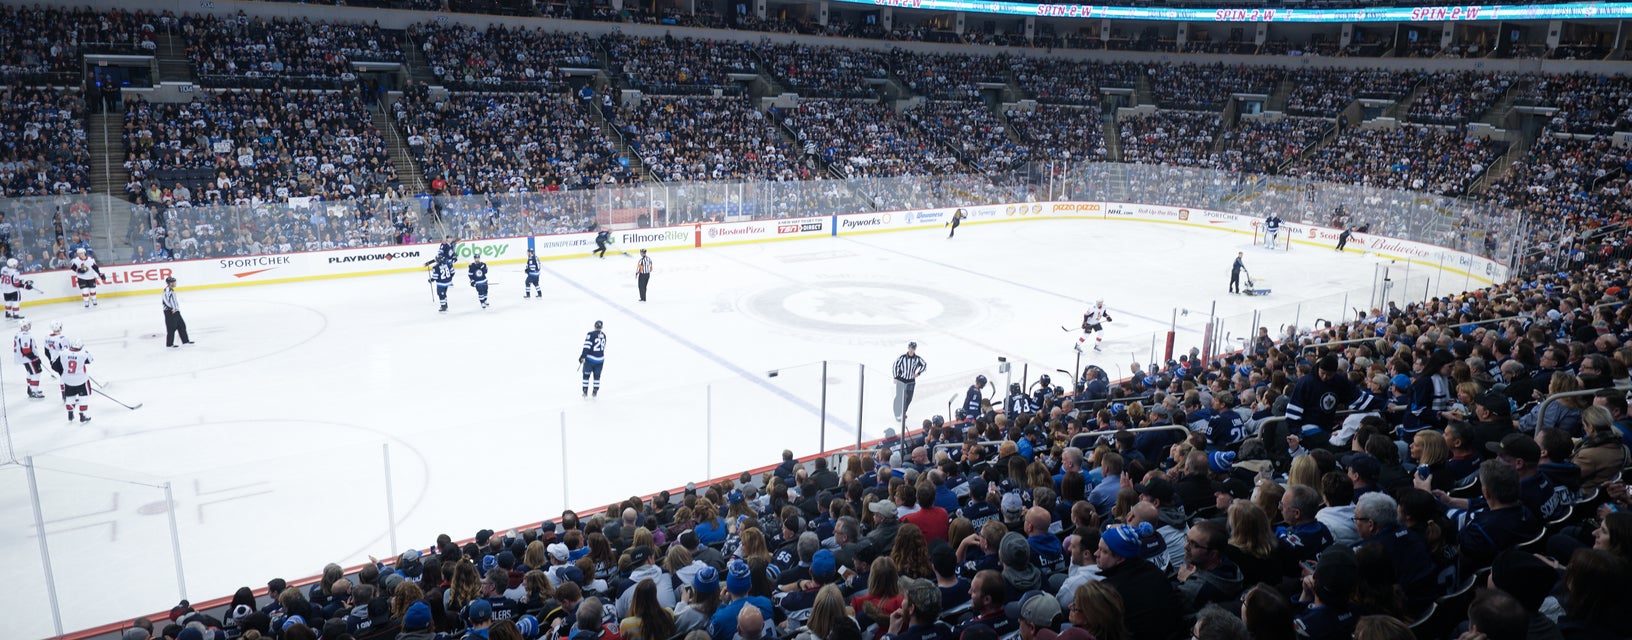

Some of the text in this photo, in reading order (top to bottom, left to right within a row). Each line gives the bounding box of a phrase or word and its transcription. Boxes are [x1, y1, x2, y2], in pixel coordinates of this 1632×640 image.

[1053, 203, 1100, 215] pizza pizza
[842, 218, 881, 231] Payworks
[1371, 238, 1429, 257] Budweiser
[219, 255, 291, 269] SPORTCHEK
[71, 268, 173, 288] LLISER
[67, 360, 78, 374] 9
